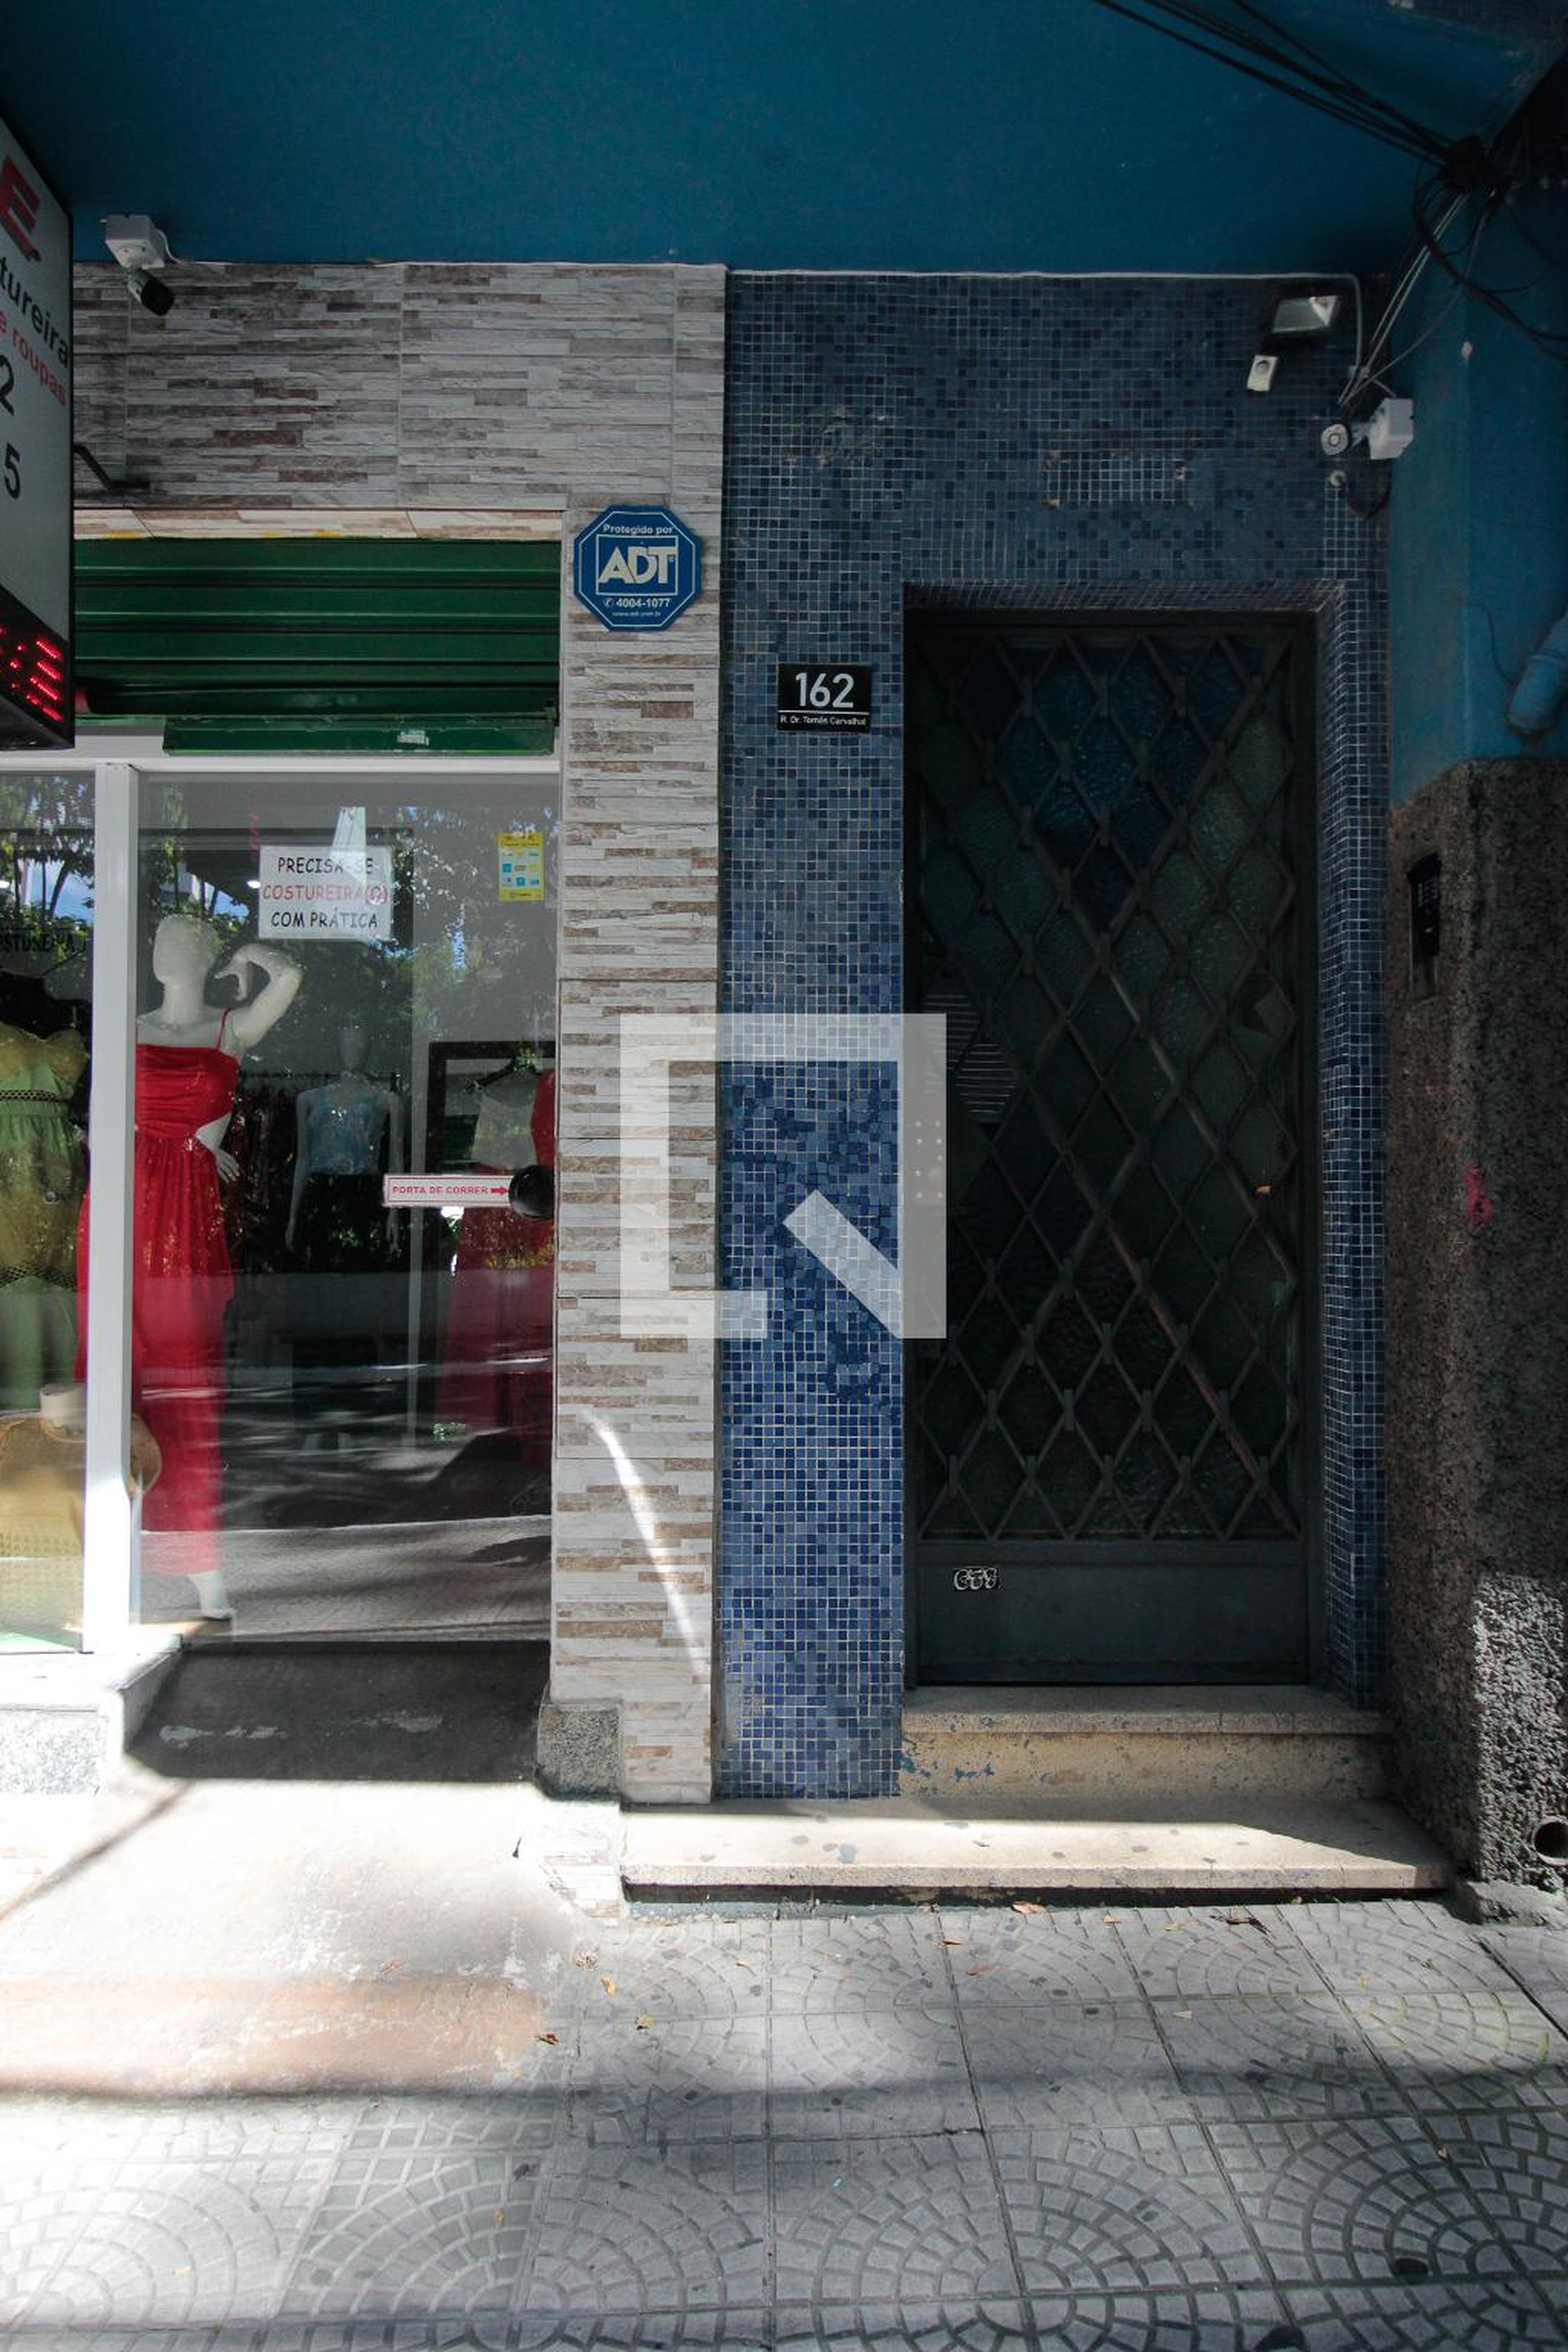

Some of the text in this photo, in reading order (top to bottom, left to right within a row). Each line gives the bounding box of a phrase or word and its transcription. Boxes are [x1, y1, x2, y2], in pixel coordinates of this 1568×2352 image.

[13, 328, 66, 406] roupas
[4, 441, 20, 499] 5
[603, 524, 673, 535] Protegido por
[598, 546, 677, 584] ADT
[616, 598, 670, 607] 4004-1077
[796, 672, 854, 708] 162
[790, 716, 802, 724] Dr.
[271, 907, 377, 928] COM PRÁTICA
[392, 1186, 488, 1194] PORTA DE CORRER
